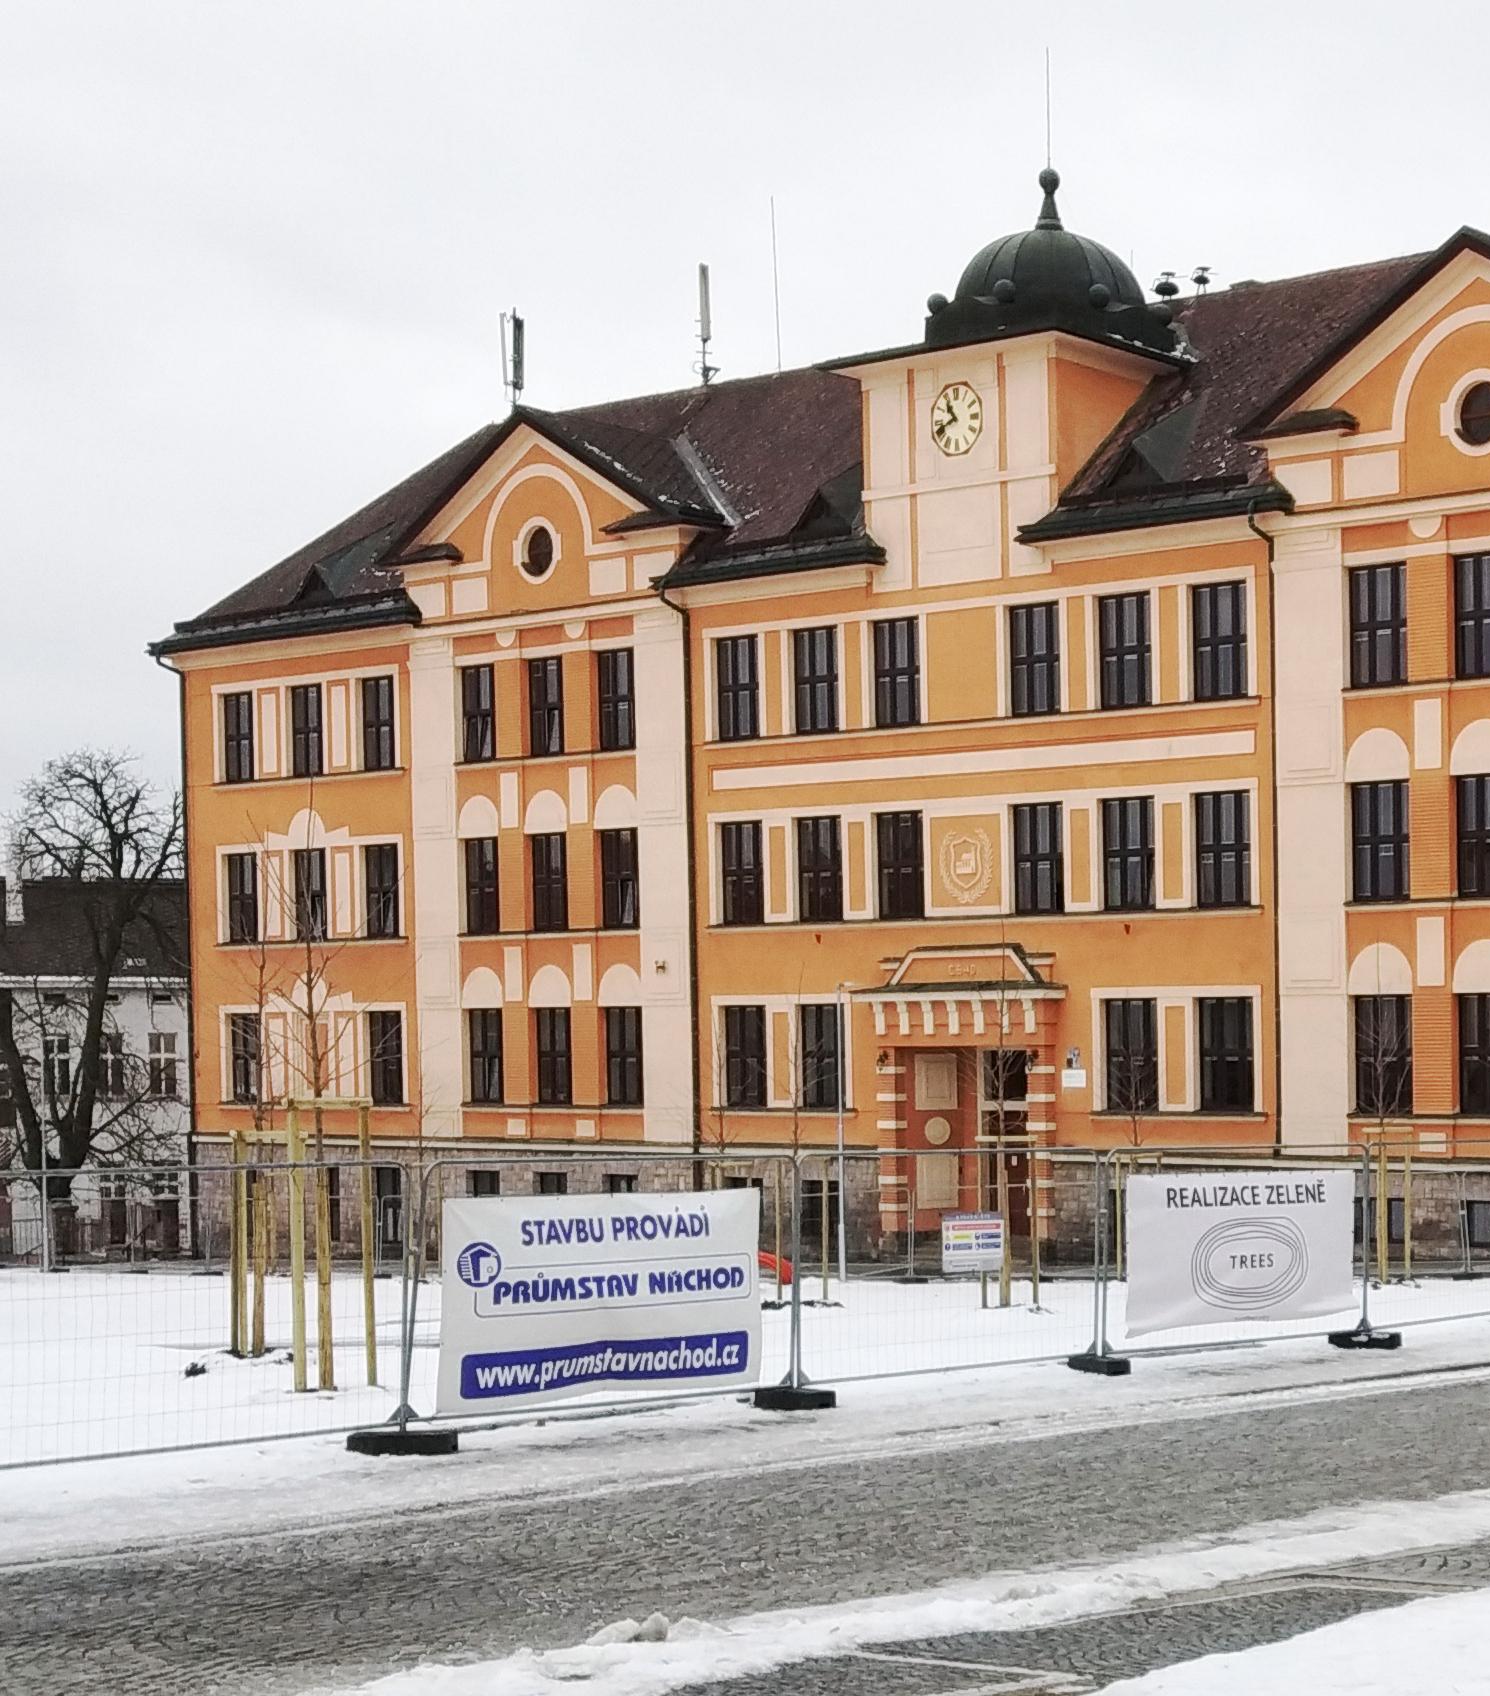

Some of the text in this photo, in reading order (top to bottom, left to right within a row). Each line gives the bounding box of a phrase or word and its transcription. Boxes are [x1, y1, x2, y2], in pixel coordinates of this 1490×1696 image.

[1166, 1178, 1327, 1209] REALIZACE ZELENĚ
[521, 1205, 710, 1247] STAVBU PROVÁDÍ
[1230, 1253, 1275, 1270] TREES
[493, 1267, 745, 1305] PRŮMSTAV NÁCHOD
[475, 1337, 741, 1389] www.prumstavnachod.cz
